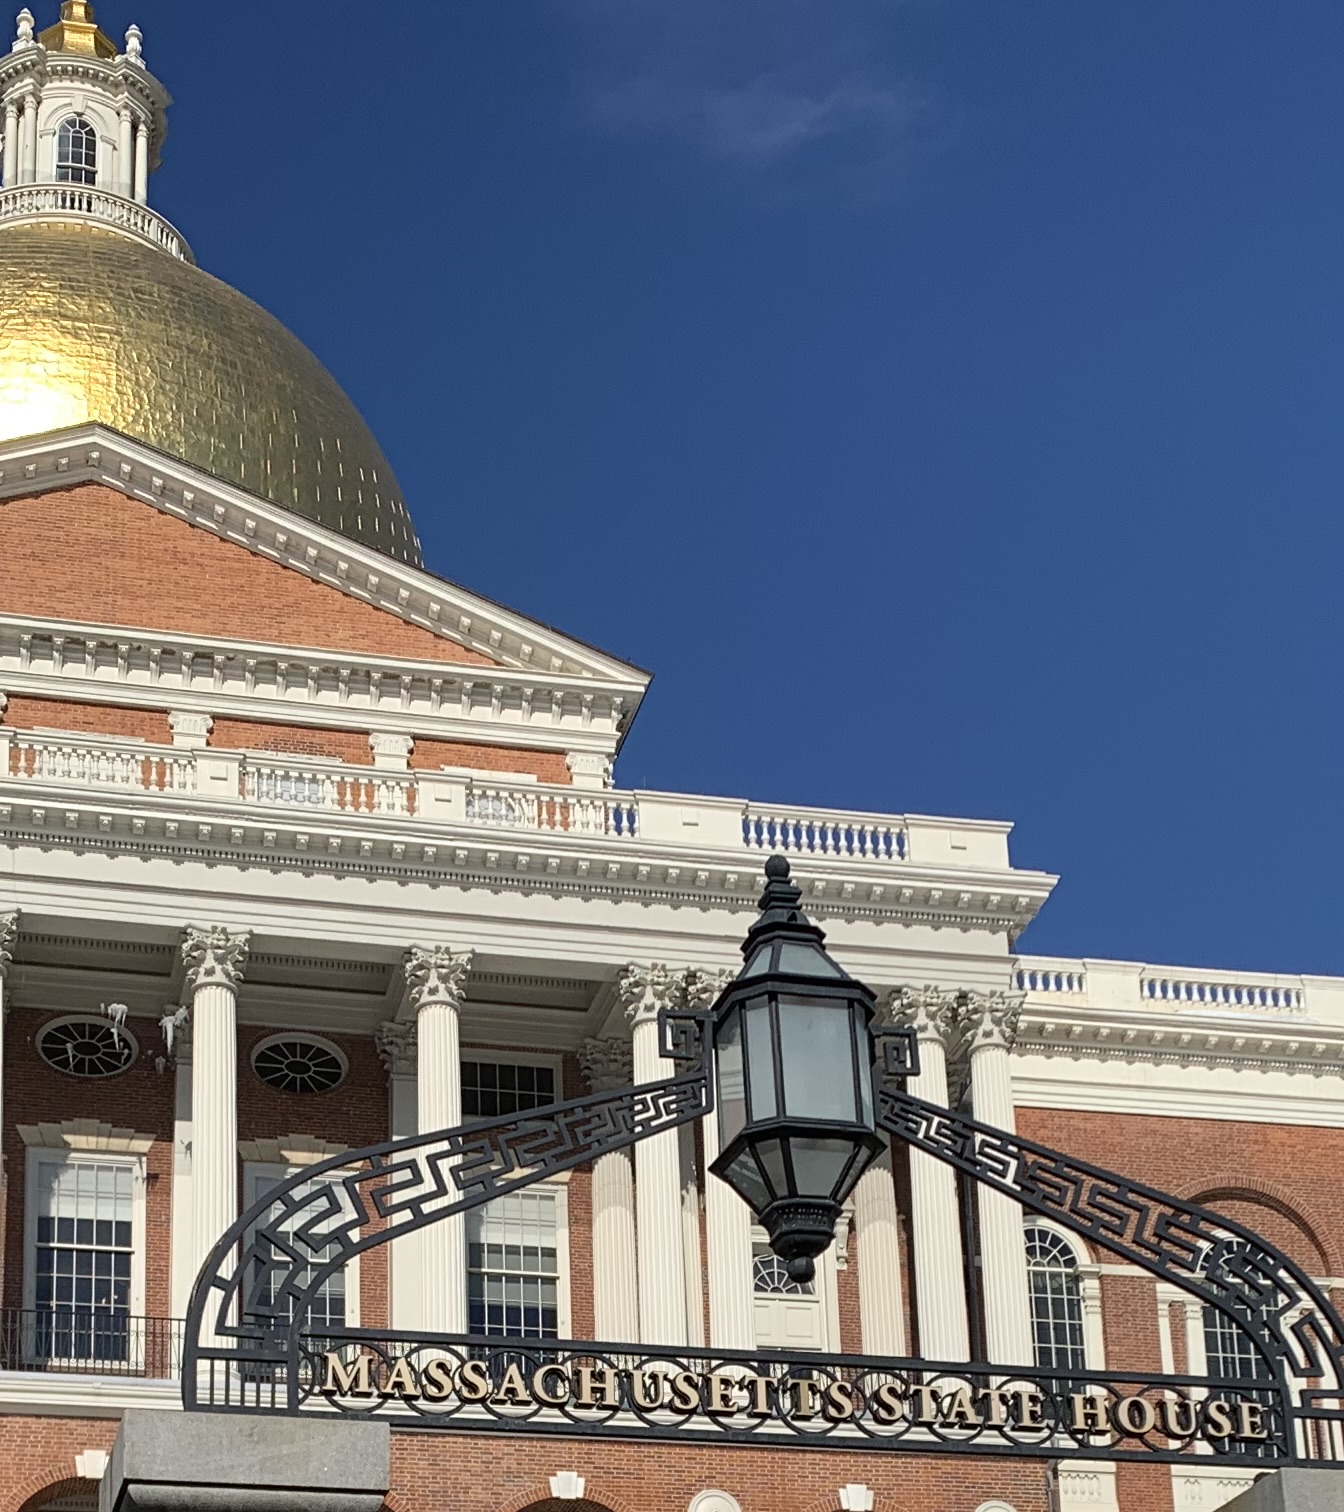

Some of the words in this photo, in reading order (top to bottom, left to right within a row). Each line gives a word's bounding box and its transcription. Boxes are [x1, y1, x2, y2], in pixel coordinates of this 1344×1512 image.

[322, 1352, 855, 1422] MASSACHUSETTS
[877, 1381, 1048, 1431] STATE
[1071, 1392, 1269, 1441] HOUSE
